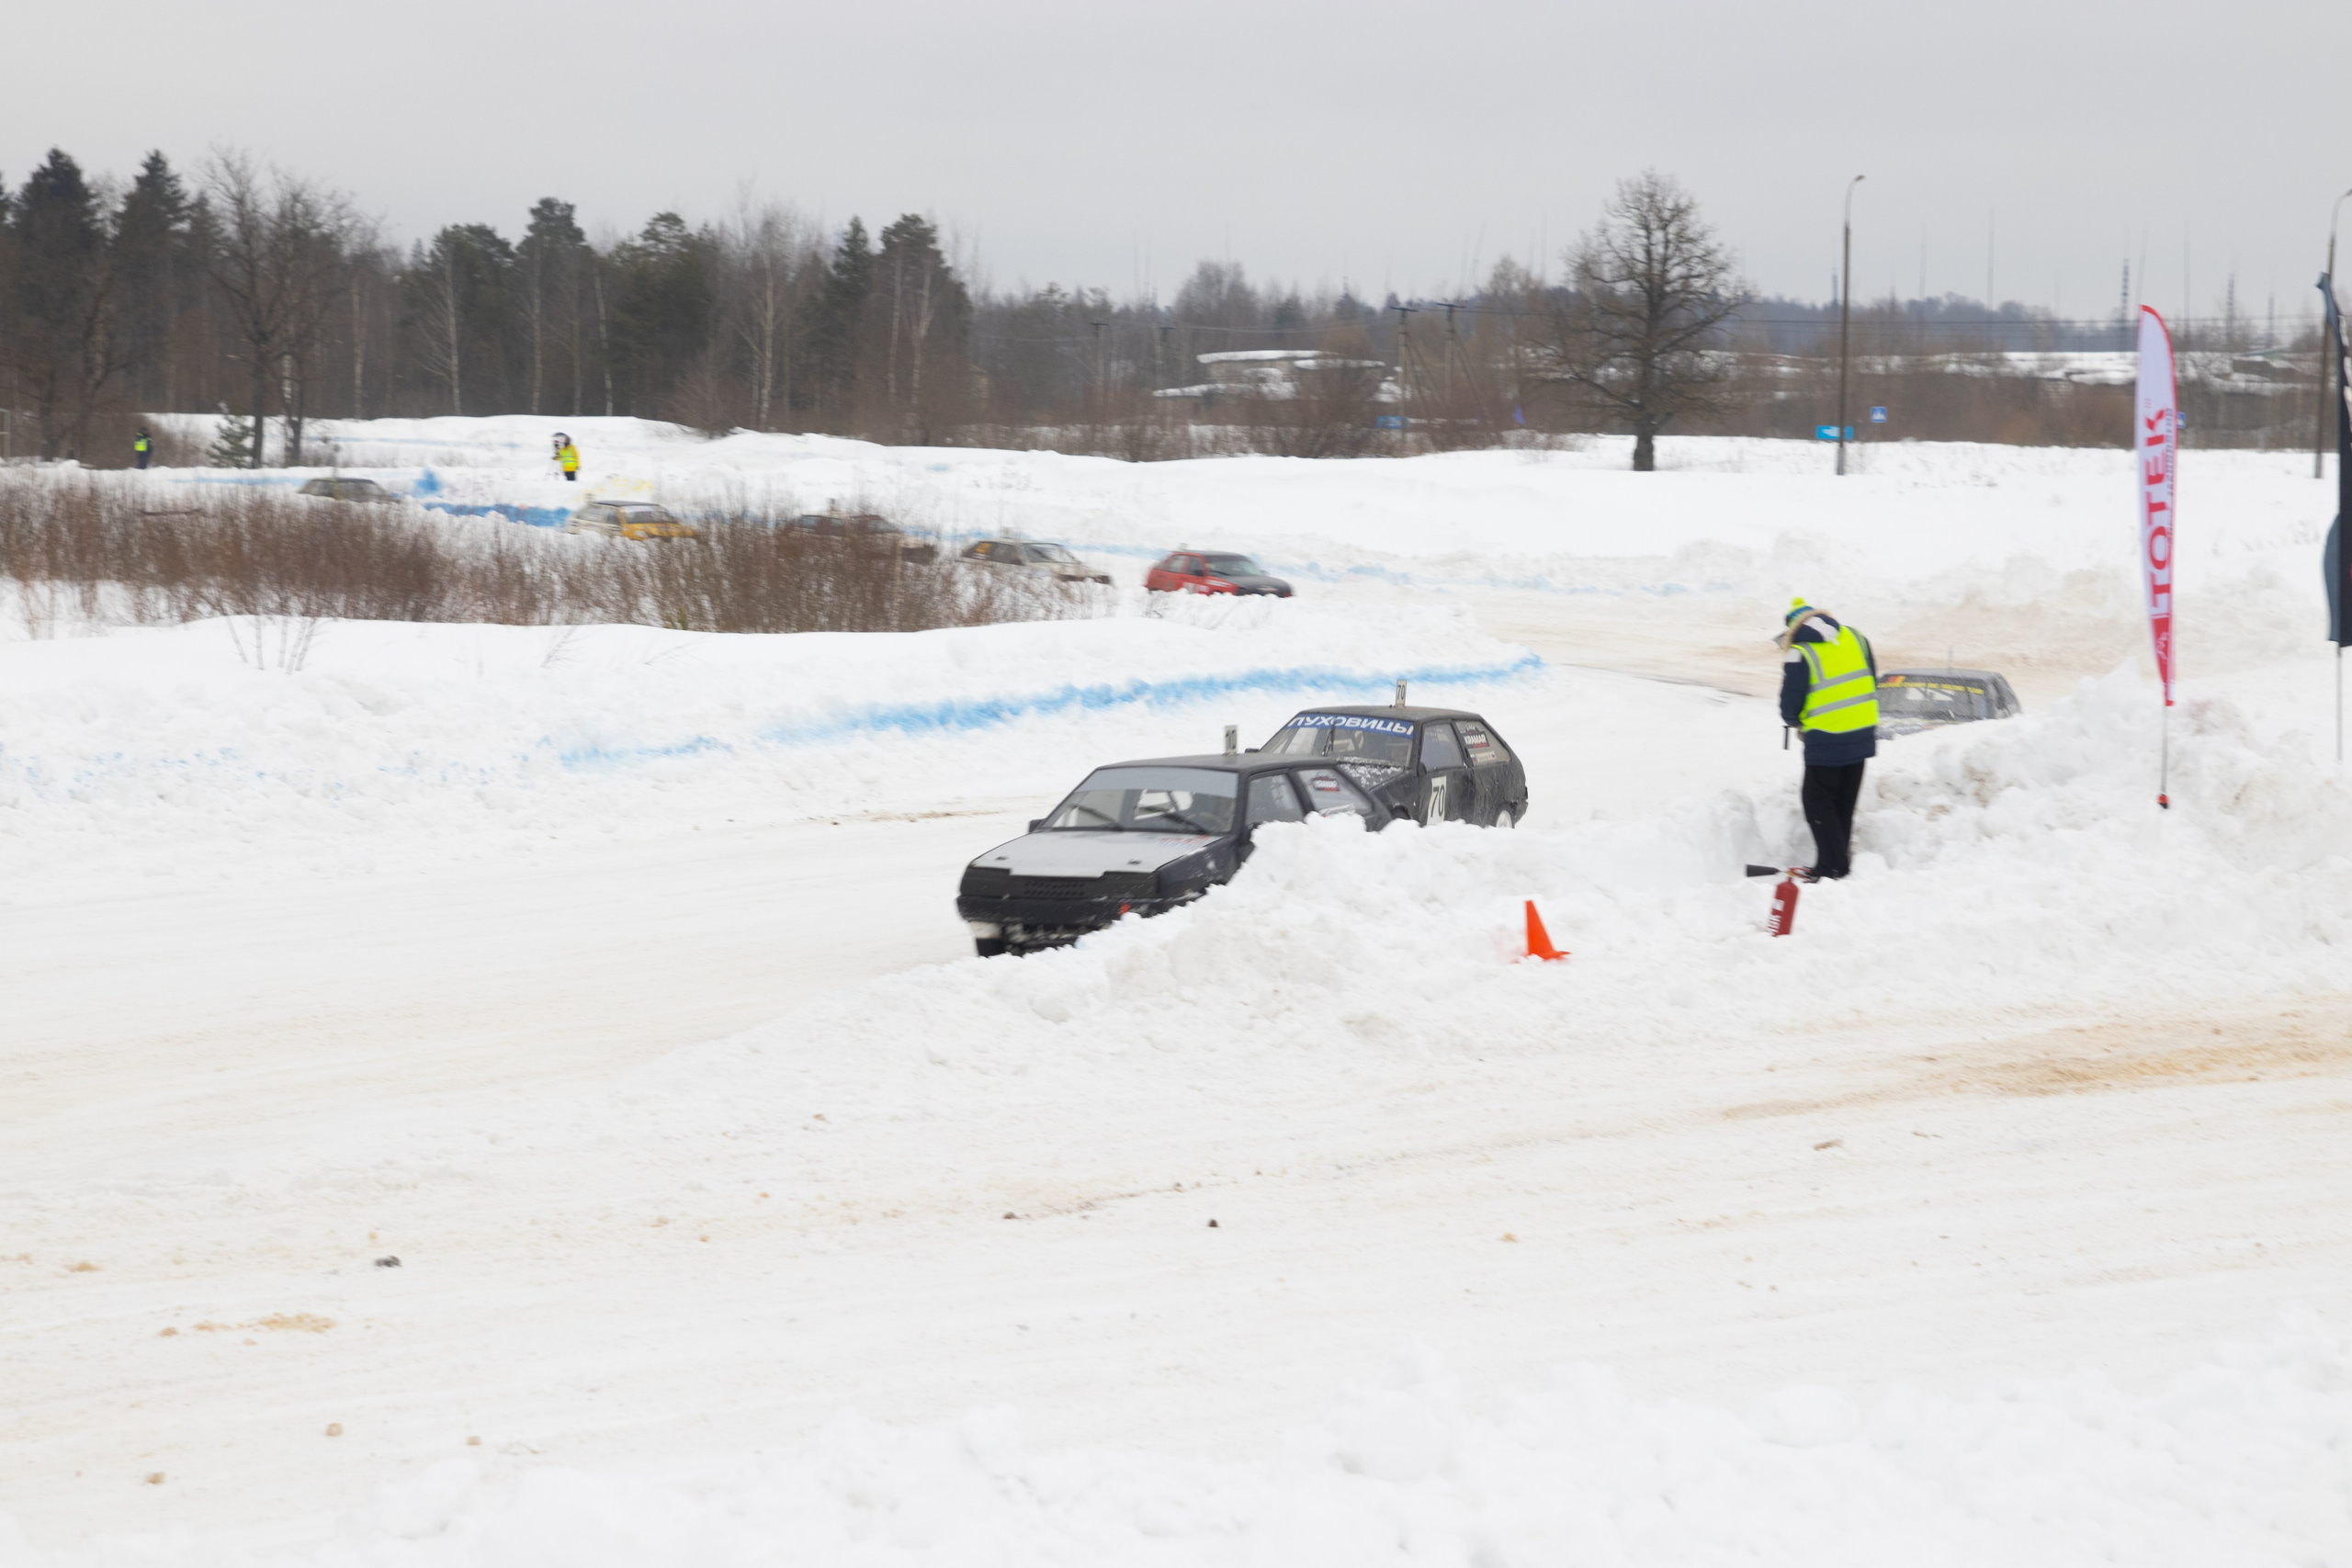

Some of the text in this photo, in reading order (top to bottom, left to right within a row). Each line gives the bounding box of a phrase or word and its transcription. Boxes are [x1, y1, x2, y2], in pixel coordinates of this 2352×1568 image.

[1397, 684, 1406, 700] 70
[1287, 716, 1414, 735] ЛУХОВИЦЫ
[1430, 784, 1445, 818] 70
